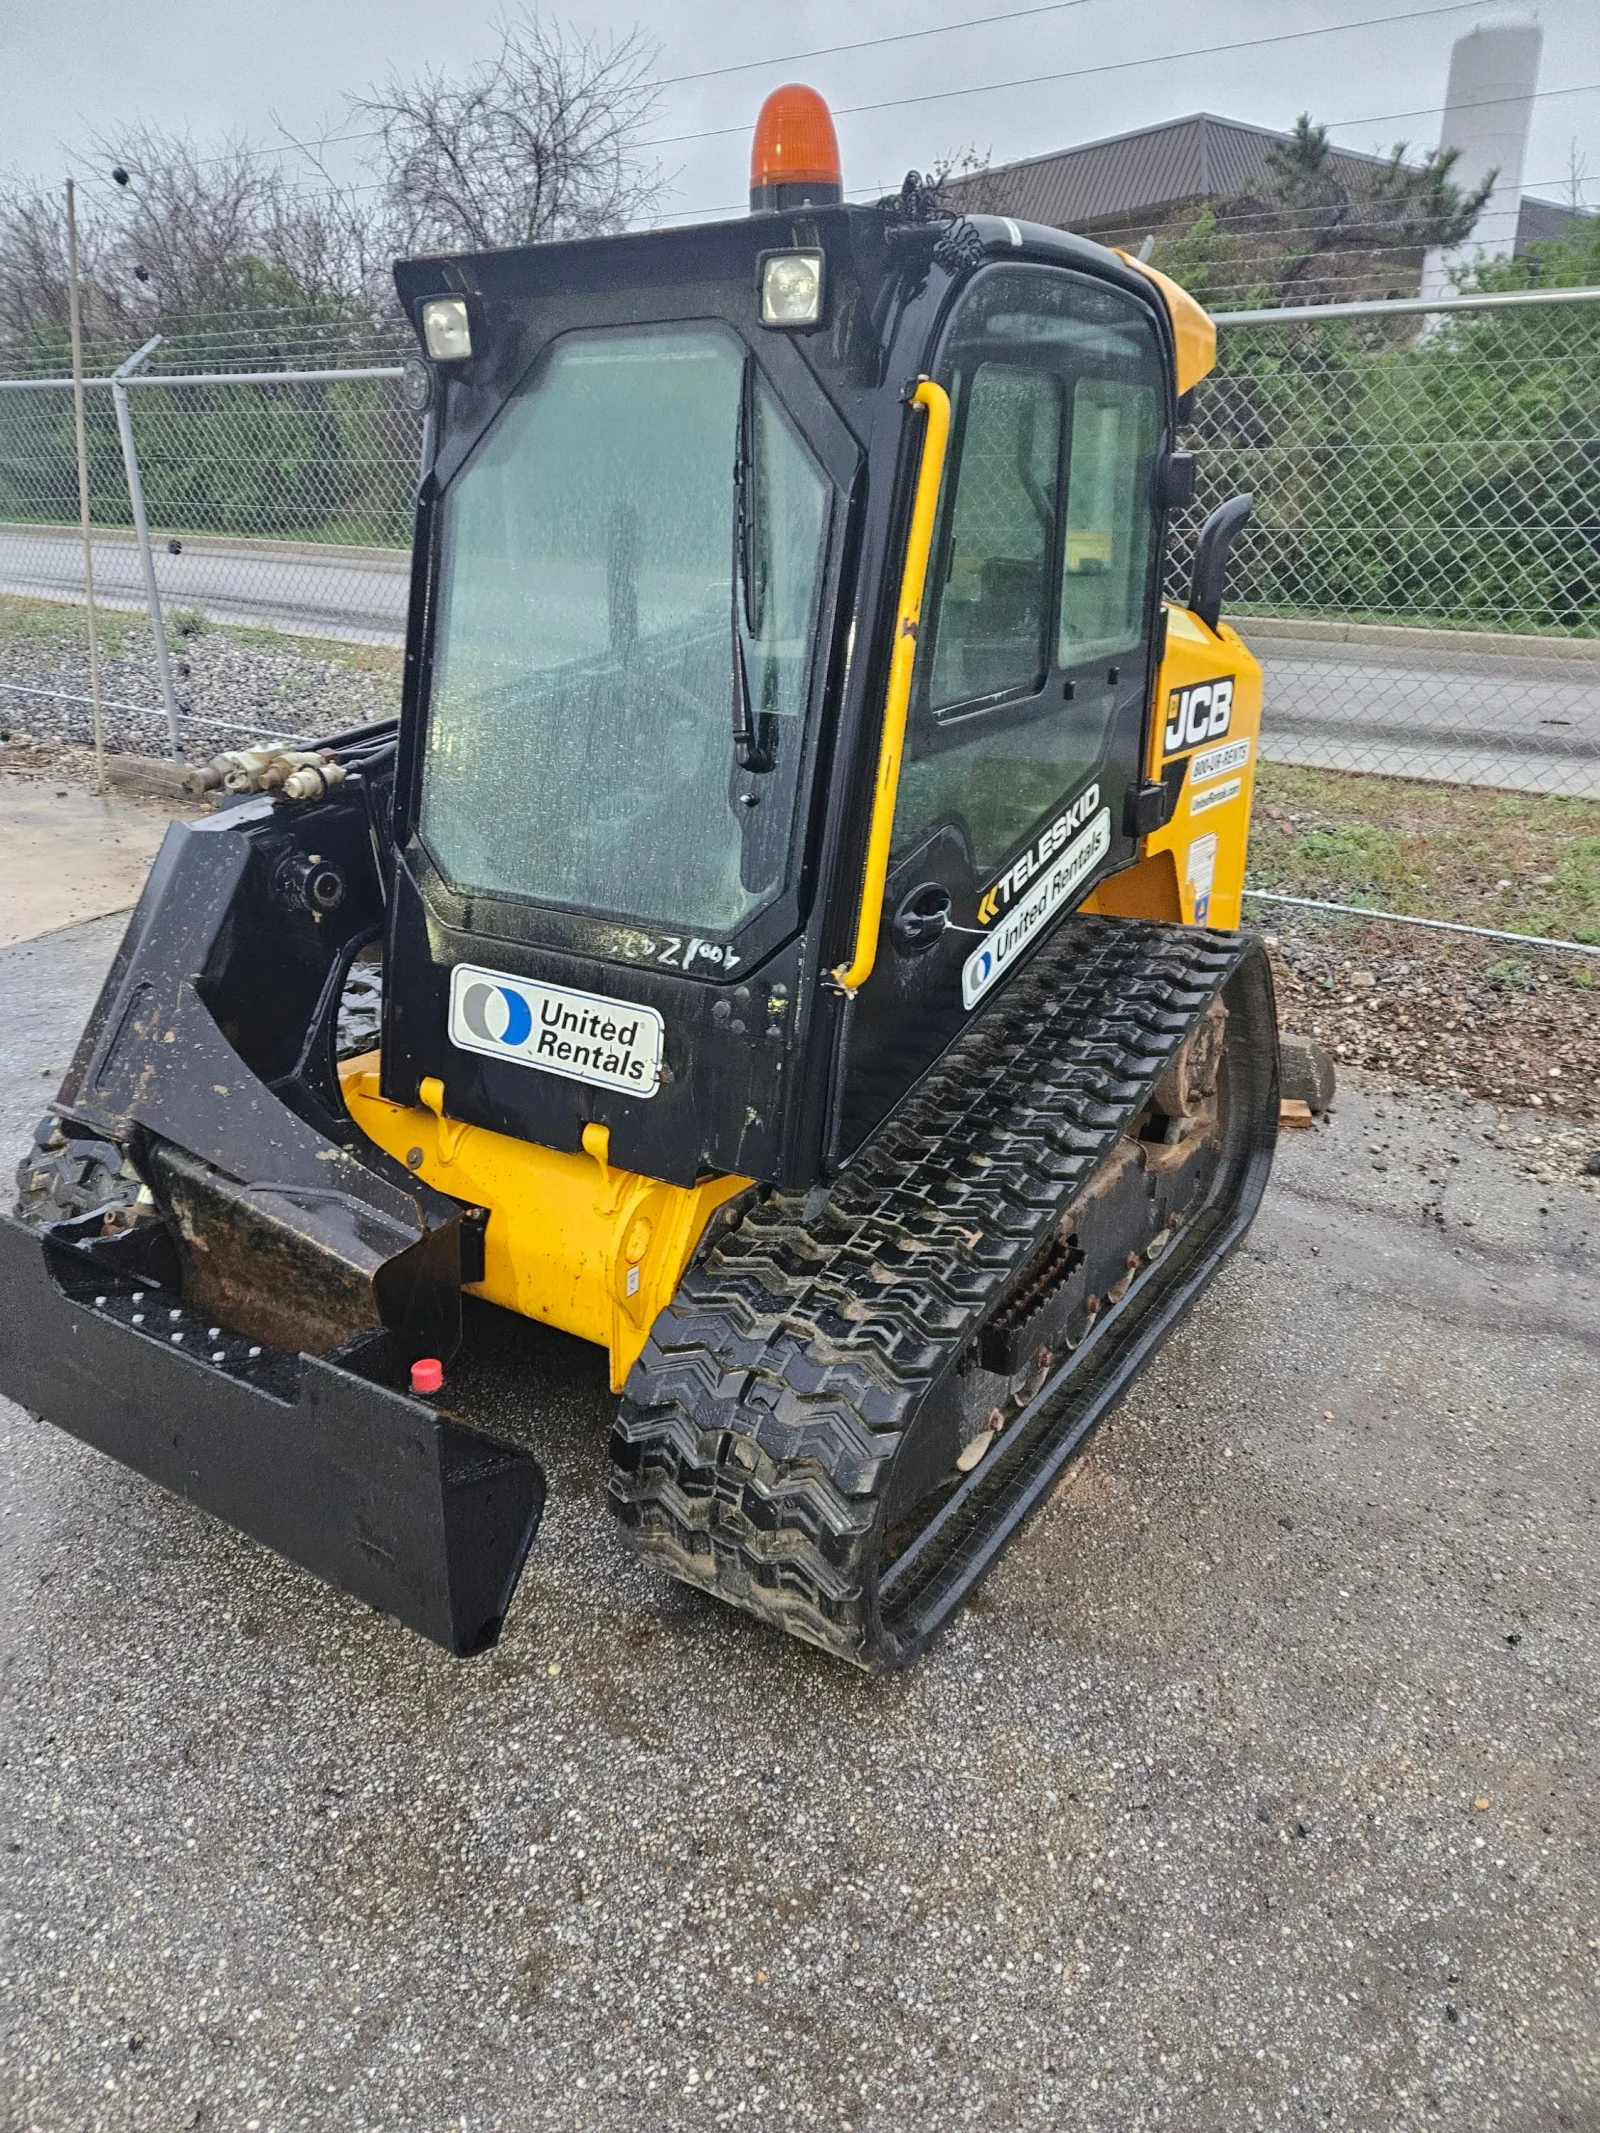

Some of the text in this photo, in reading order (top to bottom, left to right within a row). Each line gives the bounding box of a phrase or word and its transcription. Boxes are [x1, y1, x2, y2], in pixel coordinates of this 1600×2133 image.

[1165, 681, 1234, 750] JCB
[998, 783, 1099, 904] TELESKID
[996, 831, 1102, 962] United Rentals
[537, 1029, 645, 1080] Rentals
[541, 999, 639, 1047] United
